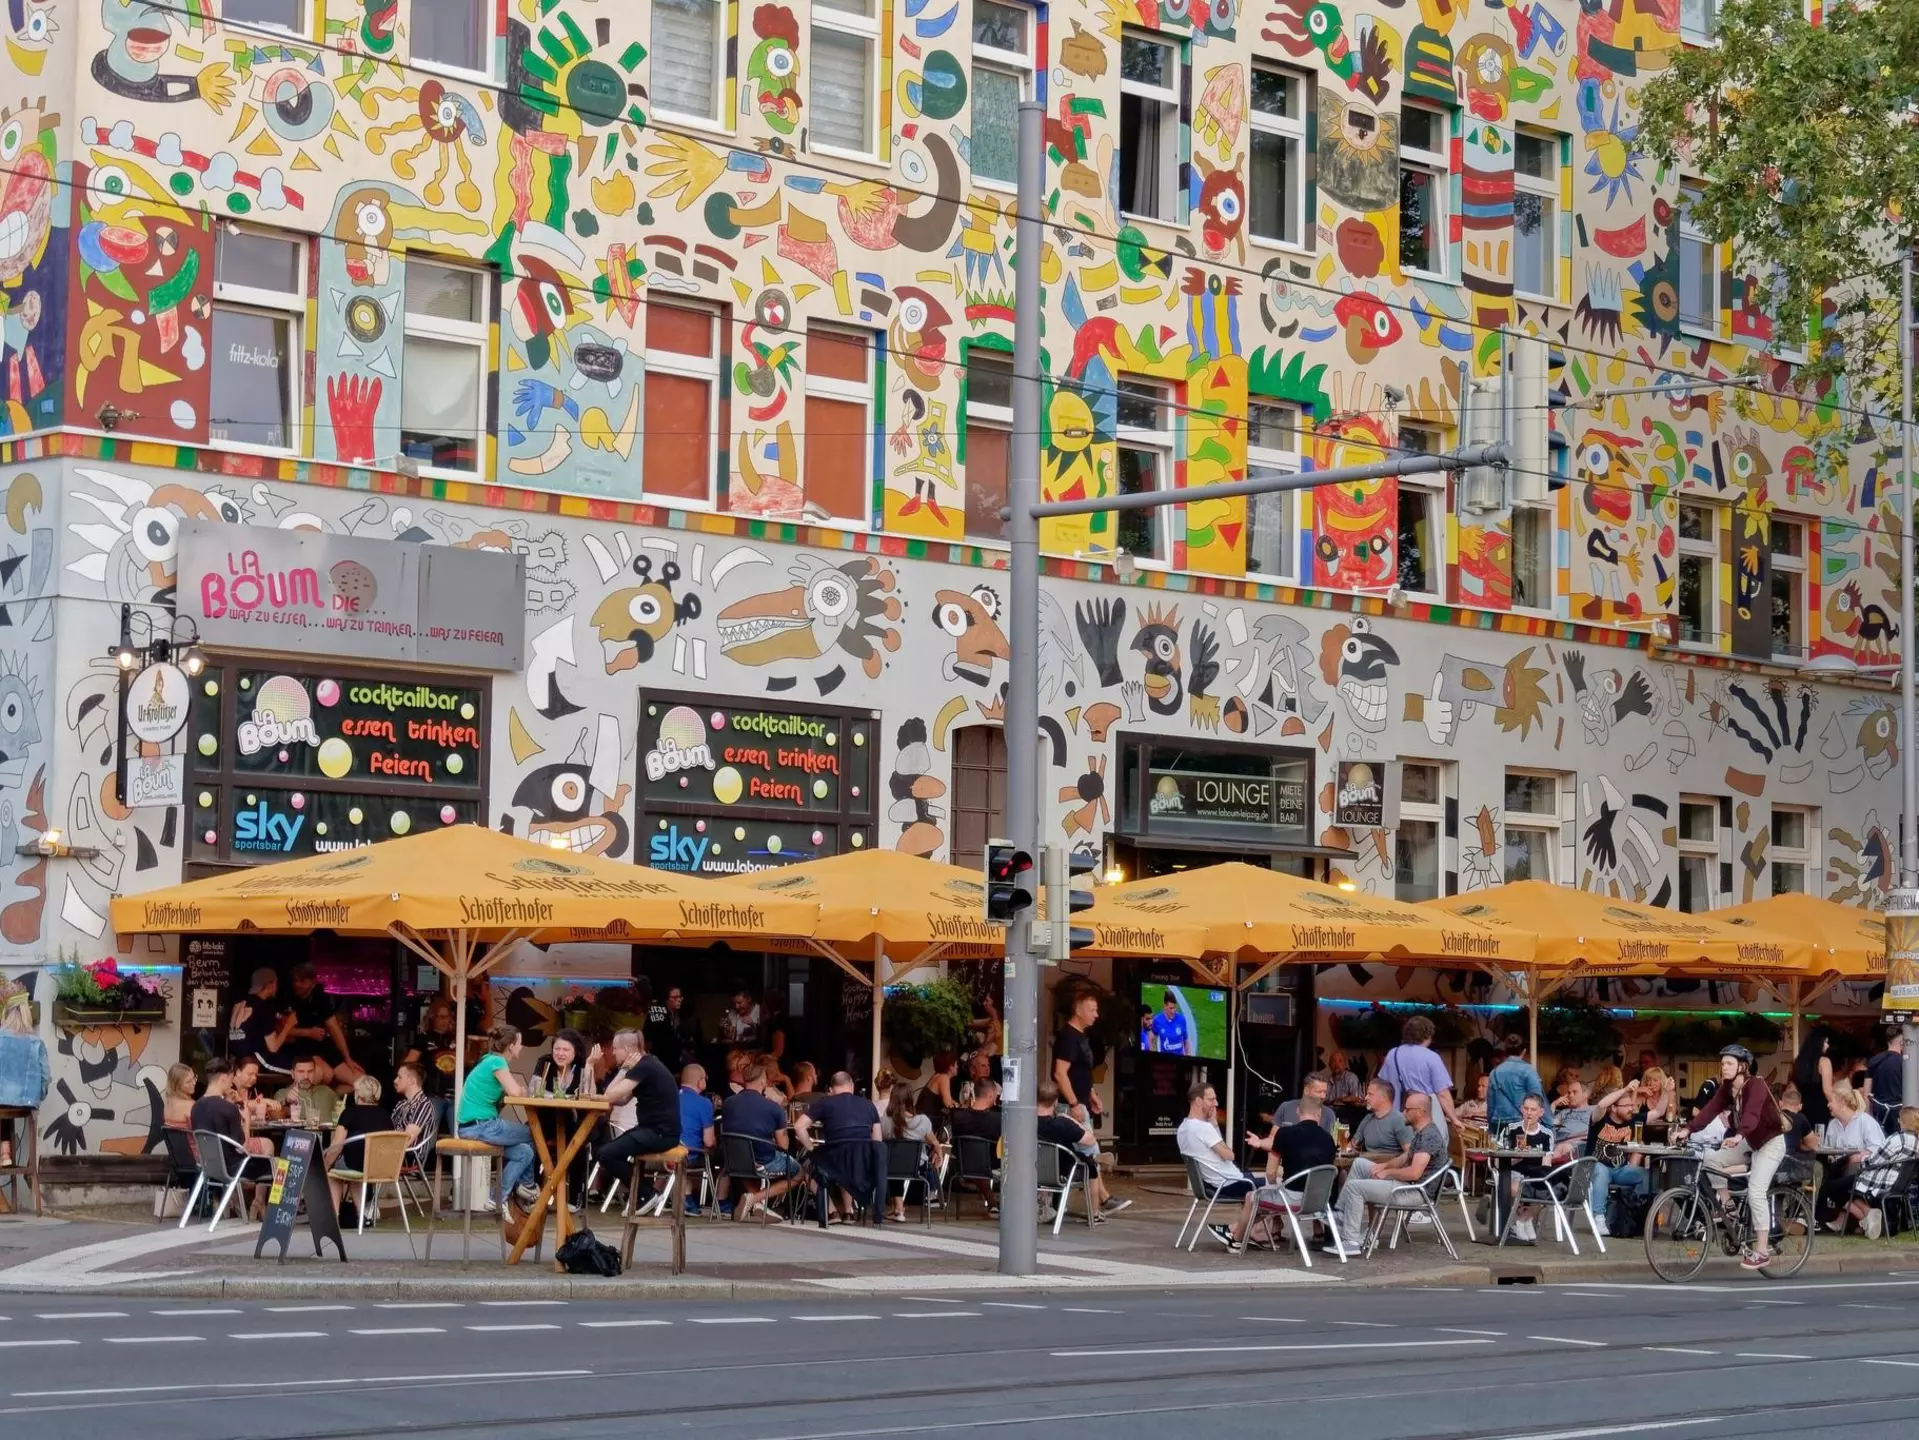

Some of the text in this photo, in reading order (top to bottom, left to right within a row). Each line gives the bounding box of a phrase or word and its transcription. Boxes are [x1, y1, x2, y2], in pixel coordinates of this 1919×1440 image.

[229, 343, 278, 368] fritz-kola
[228, 550, 265, 580] LA
[229, 609, 252, 624] WAS
[256, 610, 270, 623] ZU
[326, 618, 349, 632] WAS
[350, 619, 364, 632] ZU
[430, 627, 451, 642] WAS
[454, 629, 467, 641] ZU
[468, 630, 504, 646] FEIERN
[350, 684, 459, 712] cocktailbar
[341, 718, 479, 749] essen trinken
[731, 712, 826, 738] cocktailbar
[724, 746, 840, 775] essen trinken
[1197, 780, 1269, 806] LOUNGE
[1280, 785, 1302, 796] MIETE
[1280, 798, 1303, 810] DEINE
[236, 801, 305, 852] sky
[1342, 811, 1379, 823] LOUNGE
[235, 840, 284, 851] sportsbar
[650, 825, 708, 871] sky
[650, 861, 690, 871] sportsbar
[142, 899, 201, 928] Schöfferhofer
[285, 897, 350, 927] Schöfferhofer
[459, 894, 554, 925] Schöfferhofer
[679, 900, 765, 928] Schöfferhofer
[1095, 922, 1165, 949] Schöfferhofer
[1290, 924, 1356, 949] Schöfferhofer
[1441, 928, 1501, 955] Schöfferhofer
[1618, 938, 1670, 961] Schöfferhofer
[1737, 942, 1785, 963] Schöfferhofer
